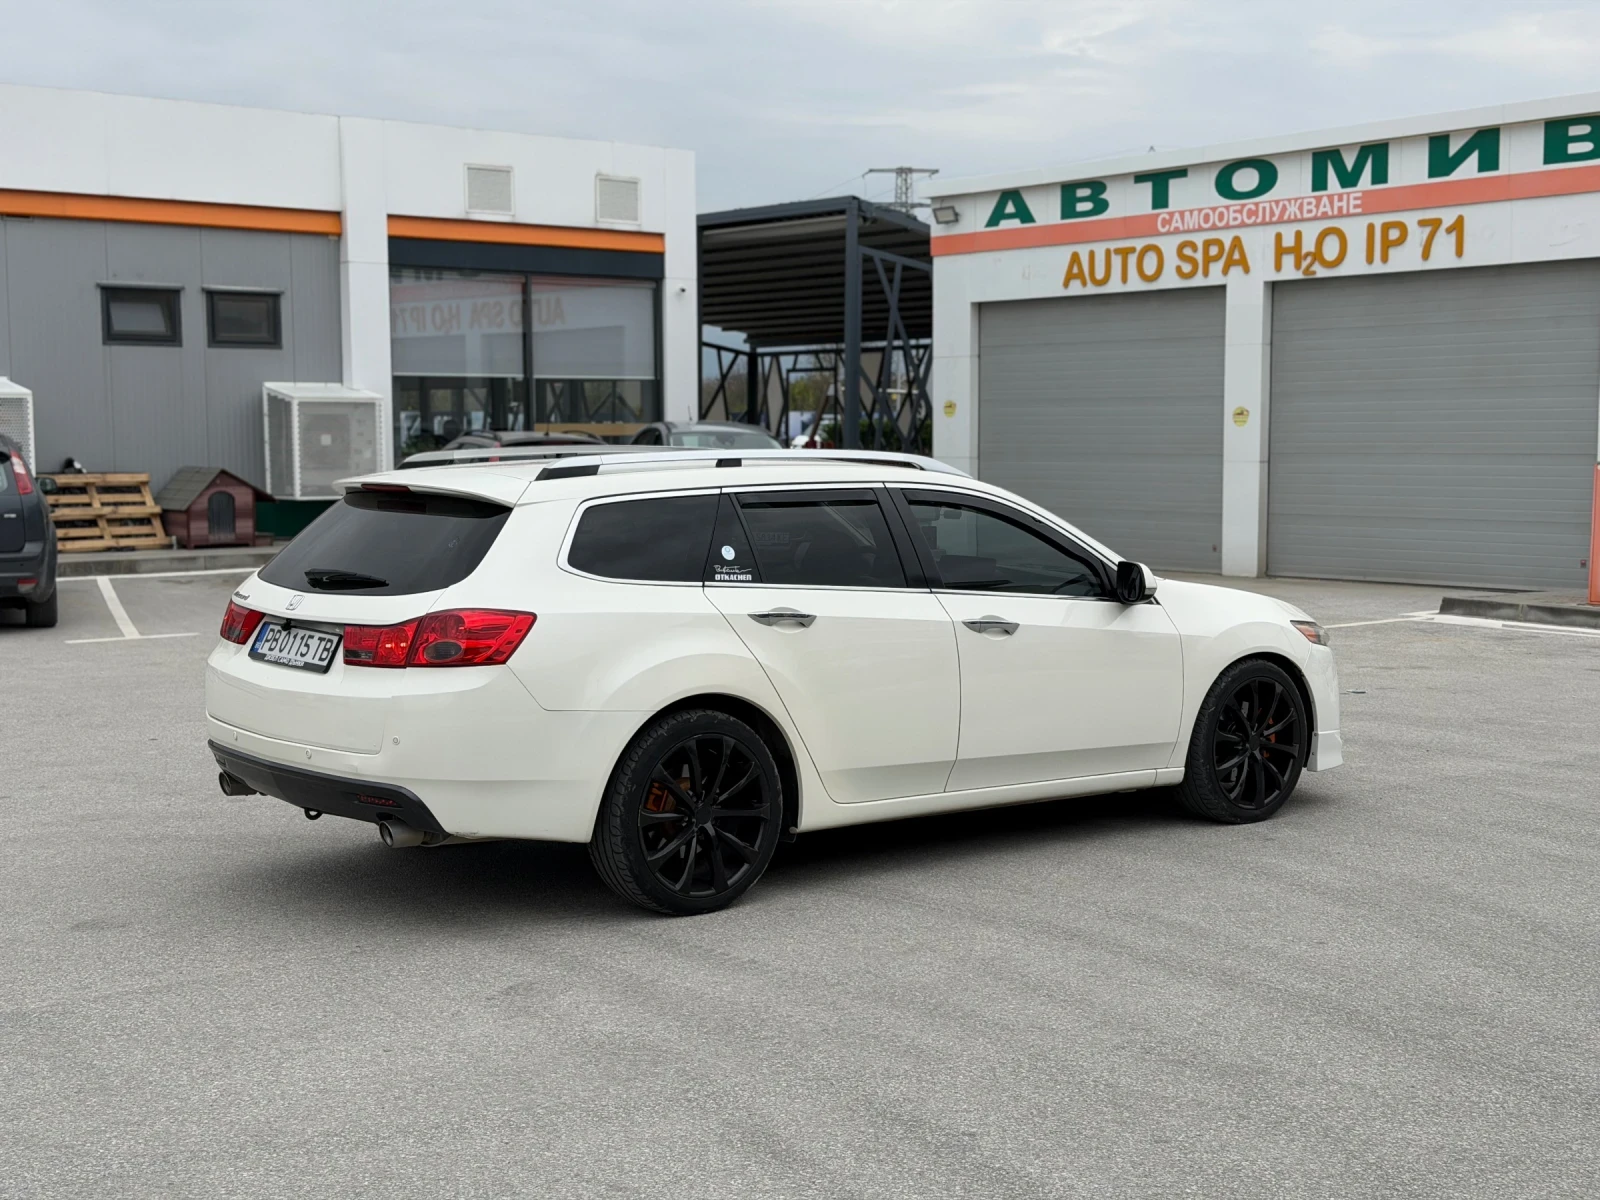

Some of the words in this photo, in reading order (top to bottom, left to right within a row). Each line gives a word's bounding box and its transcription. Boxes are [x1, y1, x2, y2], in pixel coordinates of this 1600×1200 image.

[984, 115, 1600, 228] АВТОМИВ
[1157, 192, 1363, 233] САМООБСЛУЖВАНЕ
[1063, 244, 1165, 289] AUTO
[1175, 235, 1250, 279] SPA
